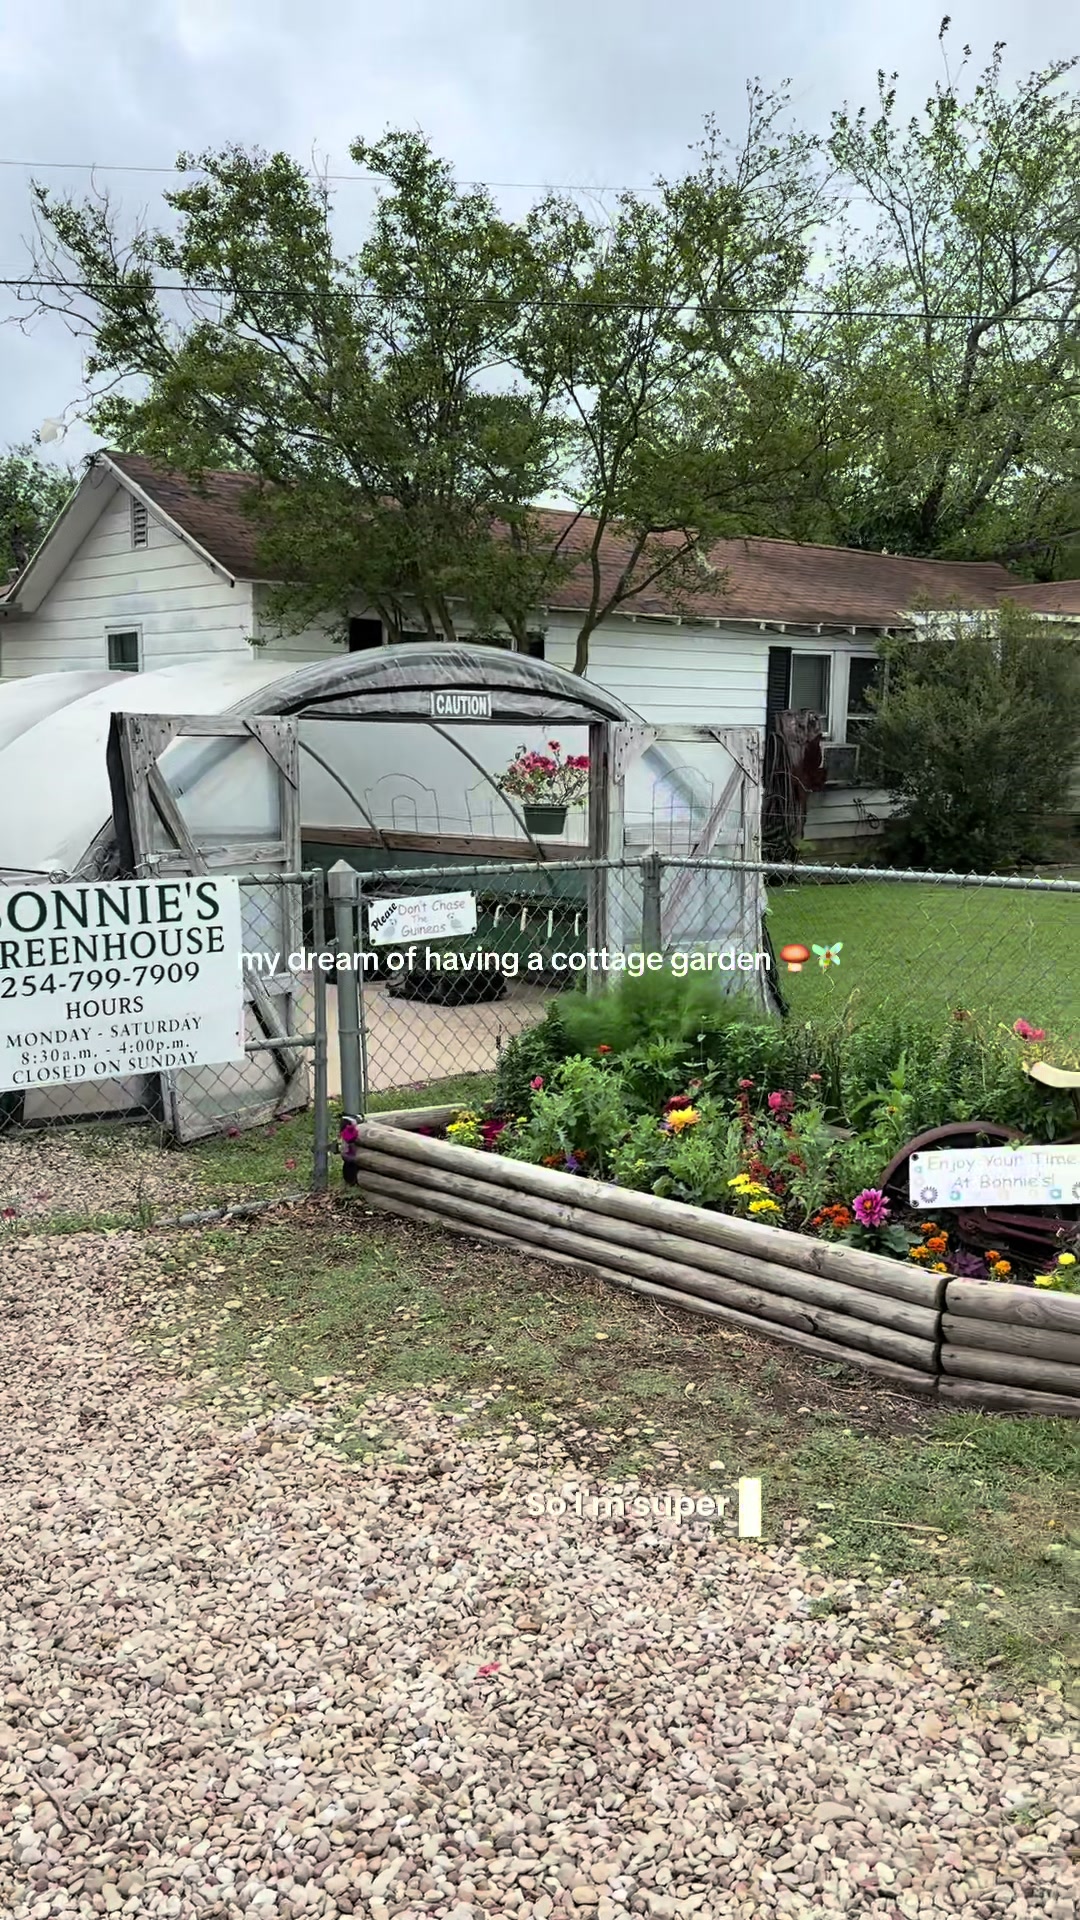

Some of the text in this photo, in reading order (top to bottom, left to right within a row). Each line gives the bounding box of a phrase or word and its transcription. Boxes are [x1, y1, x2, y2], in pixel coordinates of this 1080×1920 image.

[436, 694, 487, 715] CAUTION
[0, 882, 220, 933] ONNIE'S
[371, 902, 398, 931] Please
[397, 900, 467, 916] Don't Chase
[411, 914, 429, 923] The
[0, 926, 225, 970] REENHOUSE
[1, 962, 199, 998] 254-799-7909
[66, 996, 144, 1020] HOURS
[6, 1027, 91, 1049] MONDAY
[110, 1016, 202, 1038] SATURDAY
[21, 1048, 98, 1065] 8:30a.m.
[119, 1037, 190, 1054] 4:00p.m.
[12, 1051, 198, 1085] CLOSED ON SUNDAY
[928, 1152, 1077, 1172] Enjoy Your Time
[952, 1177, 970, 1189] At
